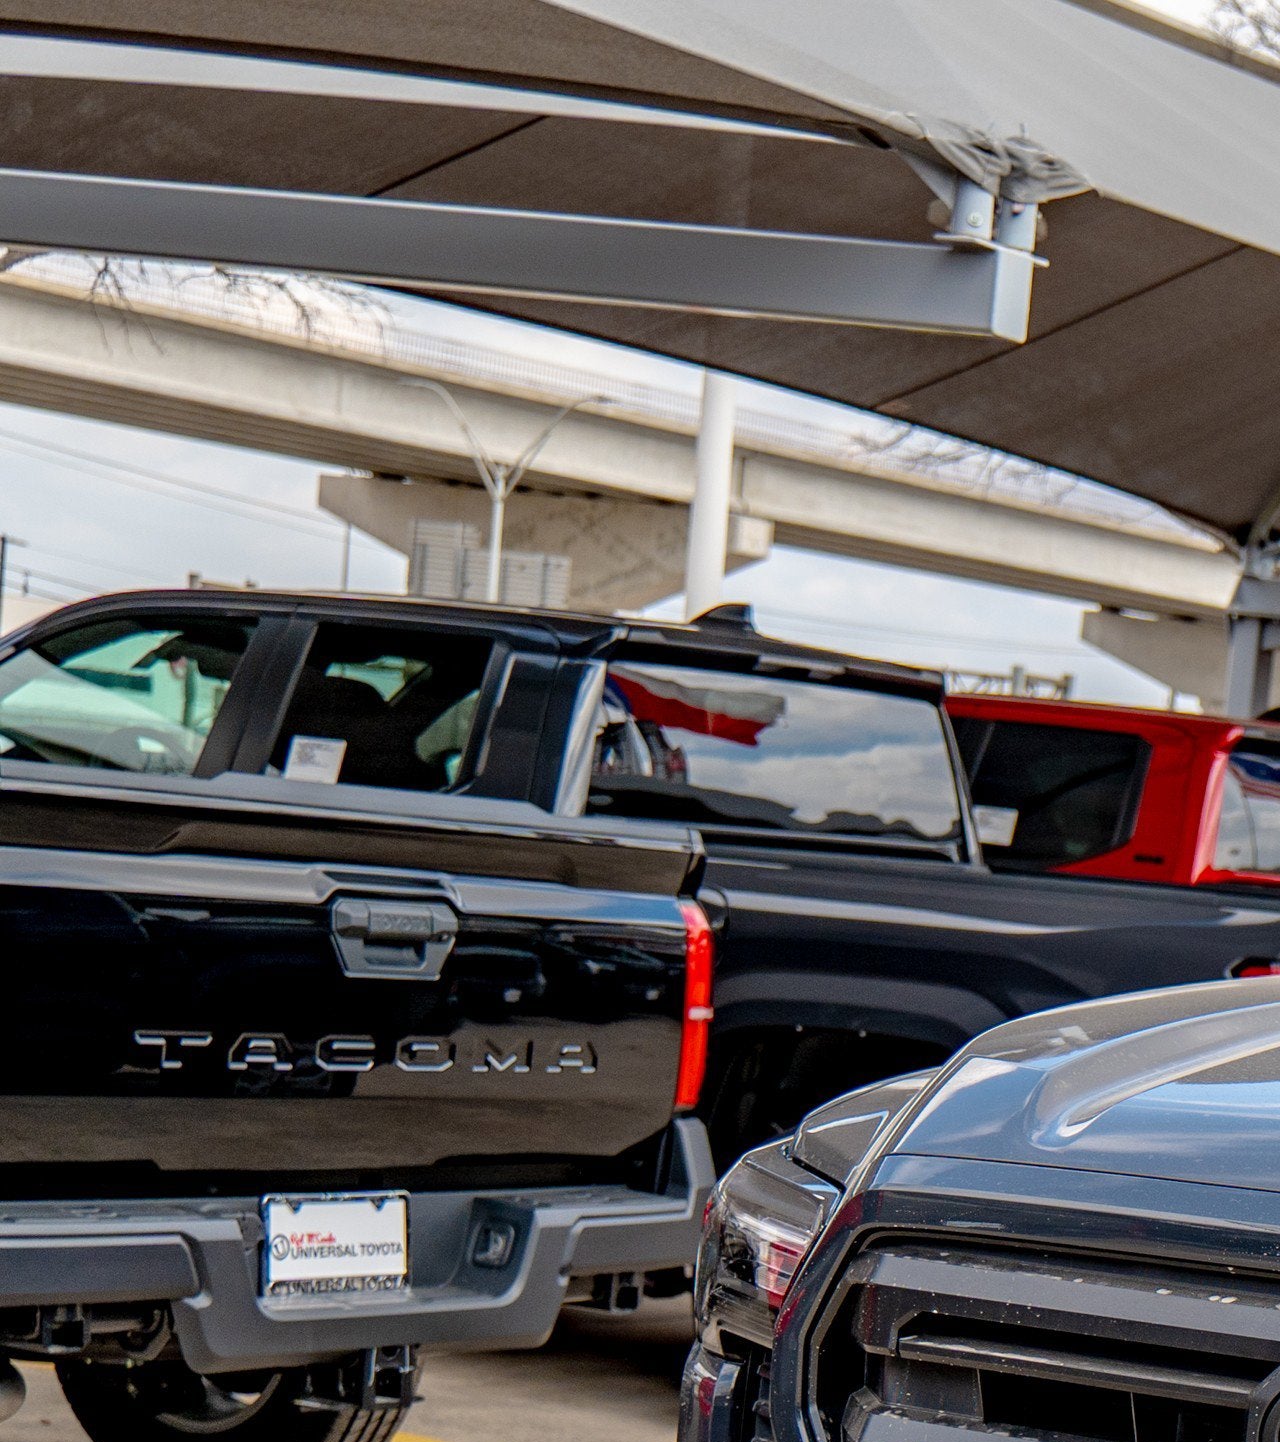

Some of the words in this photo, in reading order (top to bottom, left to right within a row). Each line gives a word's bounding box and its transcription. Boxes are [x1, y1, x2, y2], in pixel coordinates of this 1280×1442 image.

[134, 1029, 597, 1074] TACOMA
[291, 1243, 358, 1259] UNIVERSAL
[359, 1241, 404, 1257] TOYOTA
